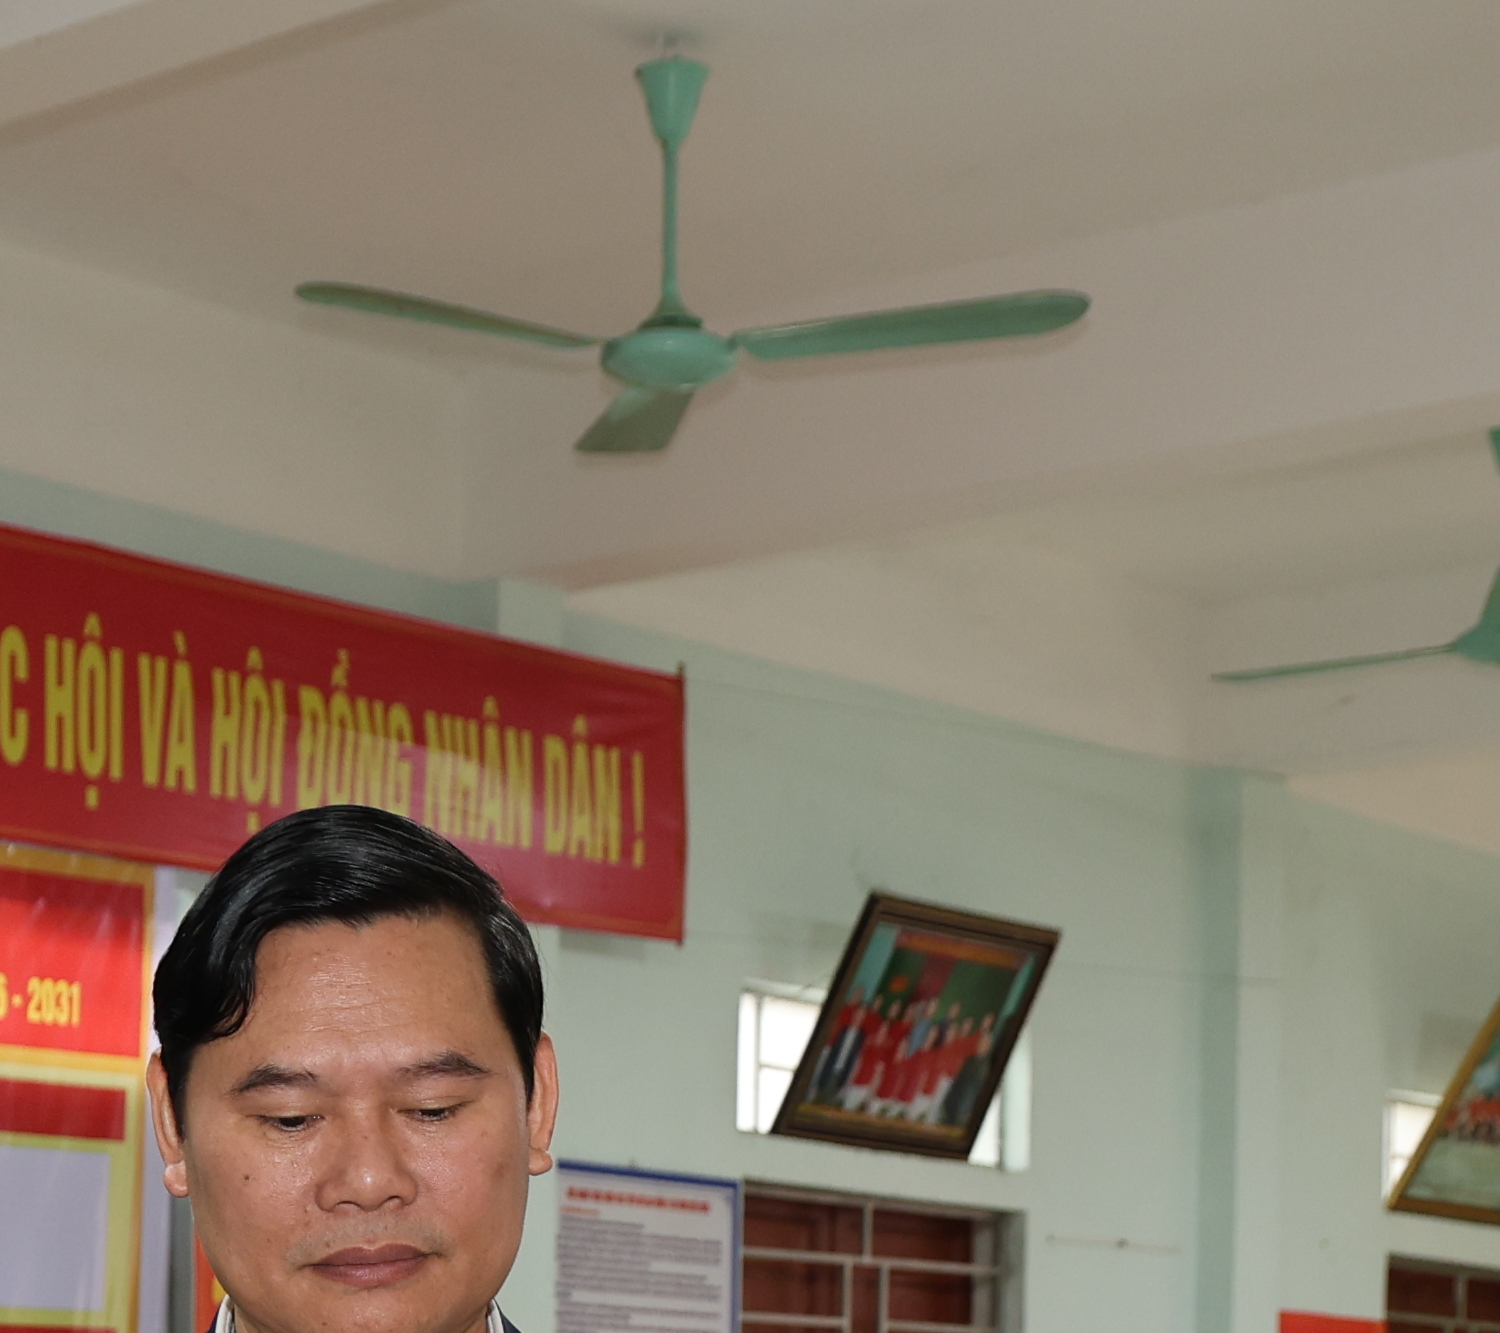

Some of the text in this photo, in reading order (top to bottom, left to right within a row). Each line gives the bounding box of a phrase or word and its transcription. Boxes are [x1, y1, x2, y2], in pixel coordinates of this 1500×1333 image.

[45, 614, 123, 809] HỘI
[139, 631, 196, 793] VÀ
[211, 648, 287, 833] HỘI
[297, 650, 415, 818] ĐỒNG
[424, 698, 533, 853] NHÂN
[544, 717, 621, 868] DÂN
[632, 751, 645, 868] !
[27, 977, 81, 1027] 2031
